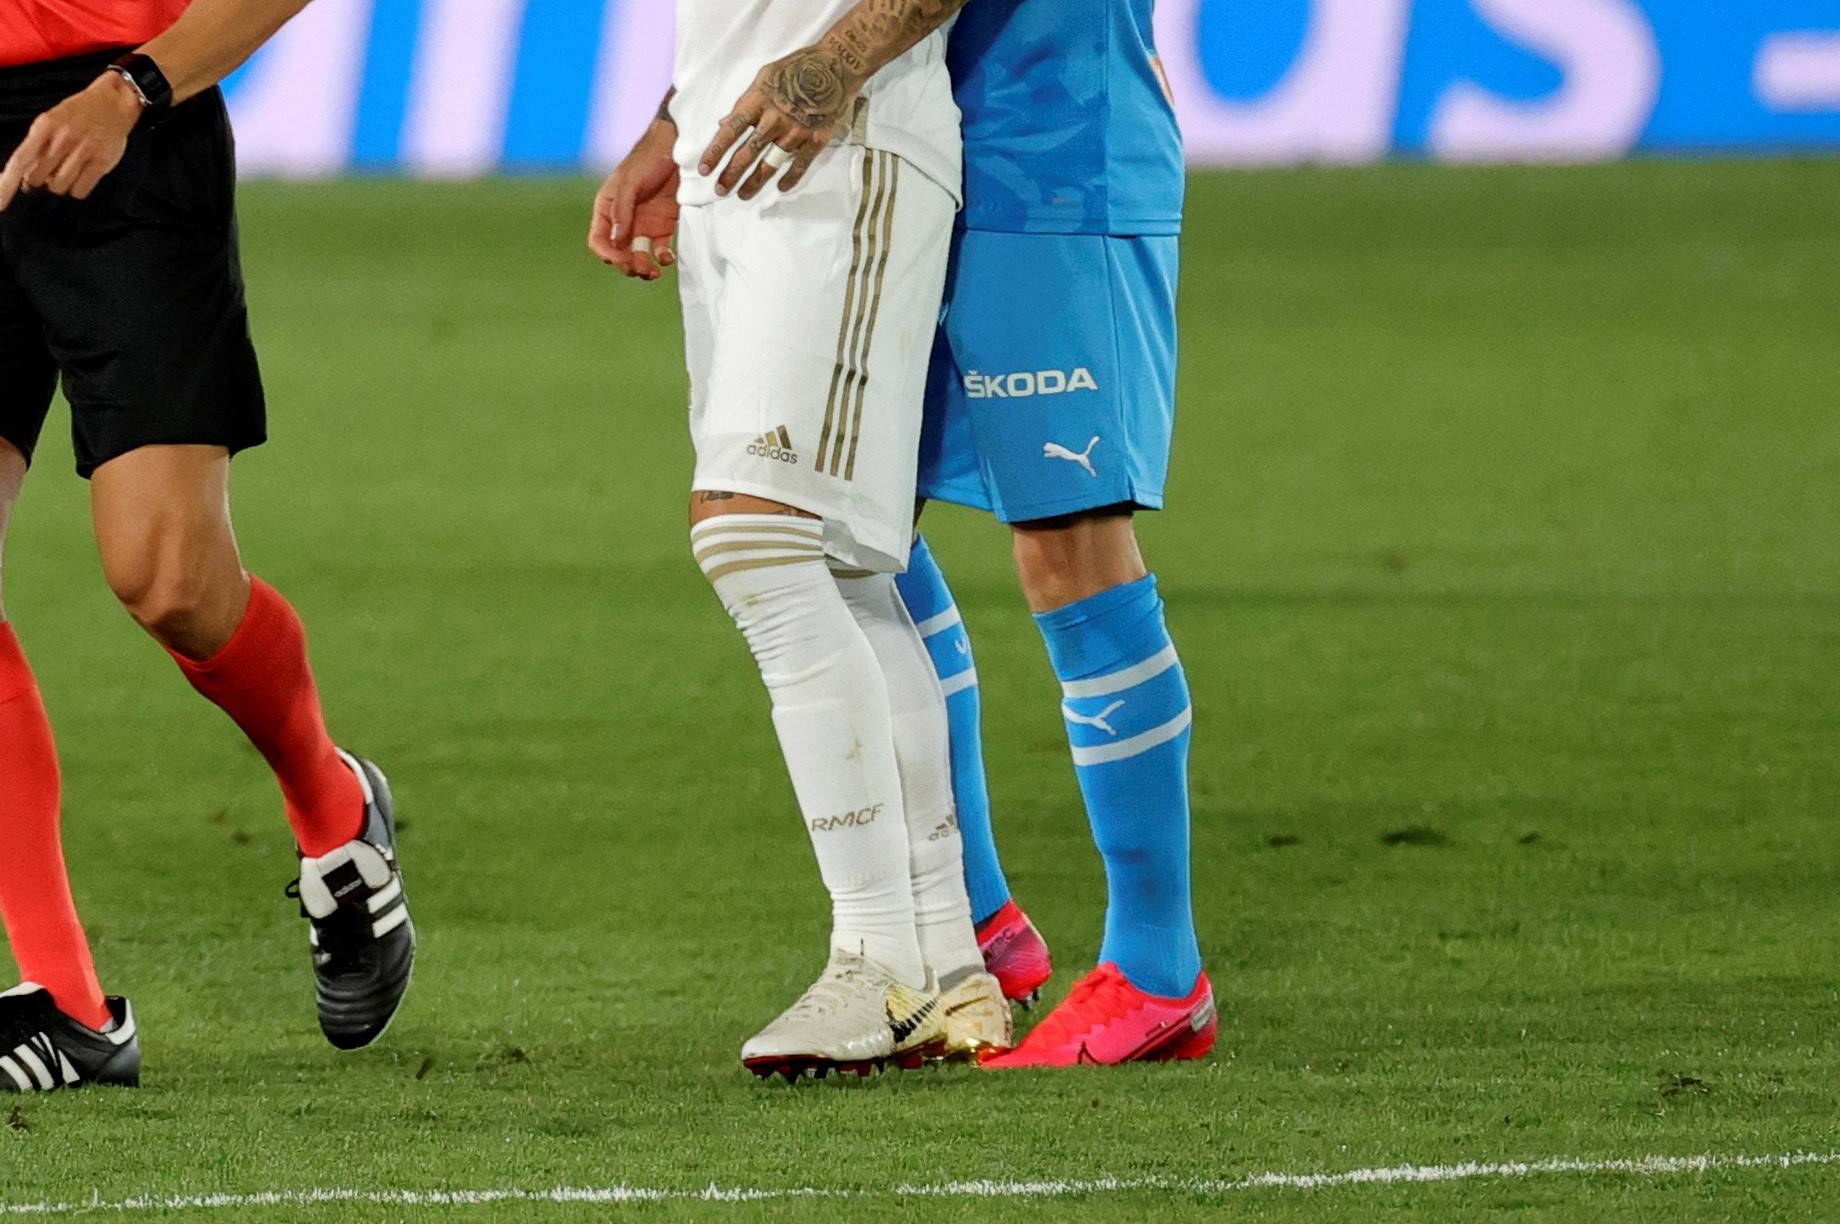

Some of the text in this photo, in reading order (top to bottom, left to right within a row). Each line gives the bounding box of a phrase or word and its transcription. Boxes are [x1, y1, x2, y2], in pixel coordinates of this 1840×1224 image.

[964, 369, 1099, 398] ŠKODA
[746, 444, 798, 464] adidas
[811, 802, 884, 832] RMCF
